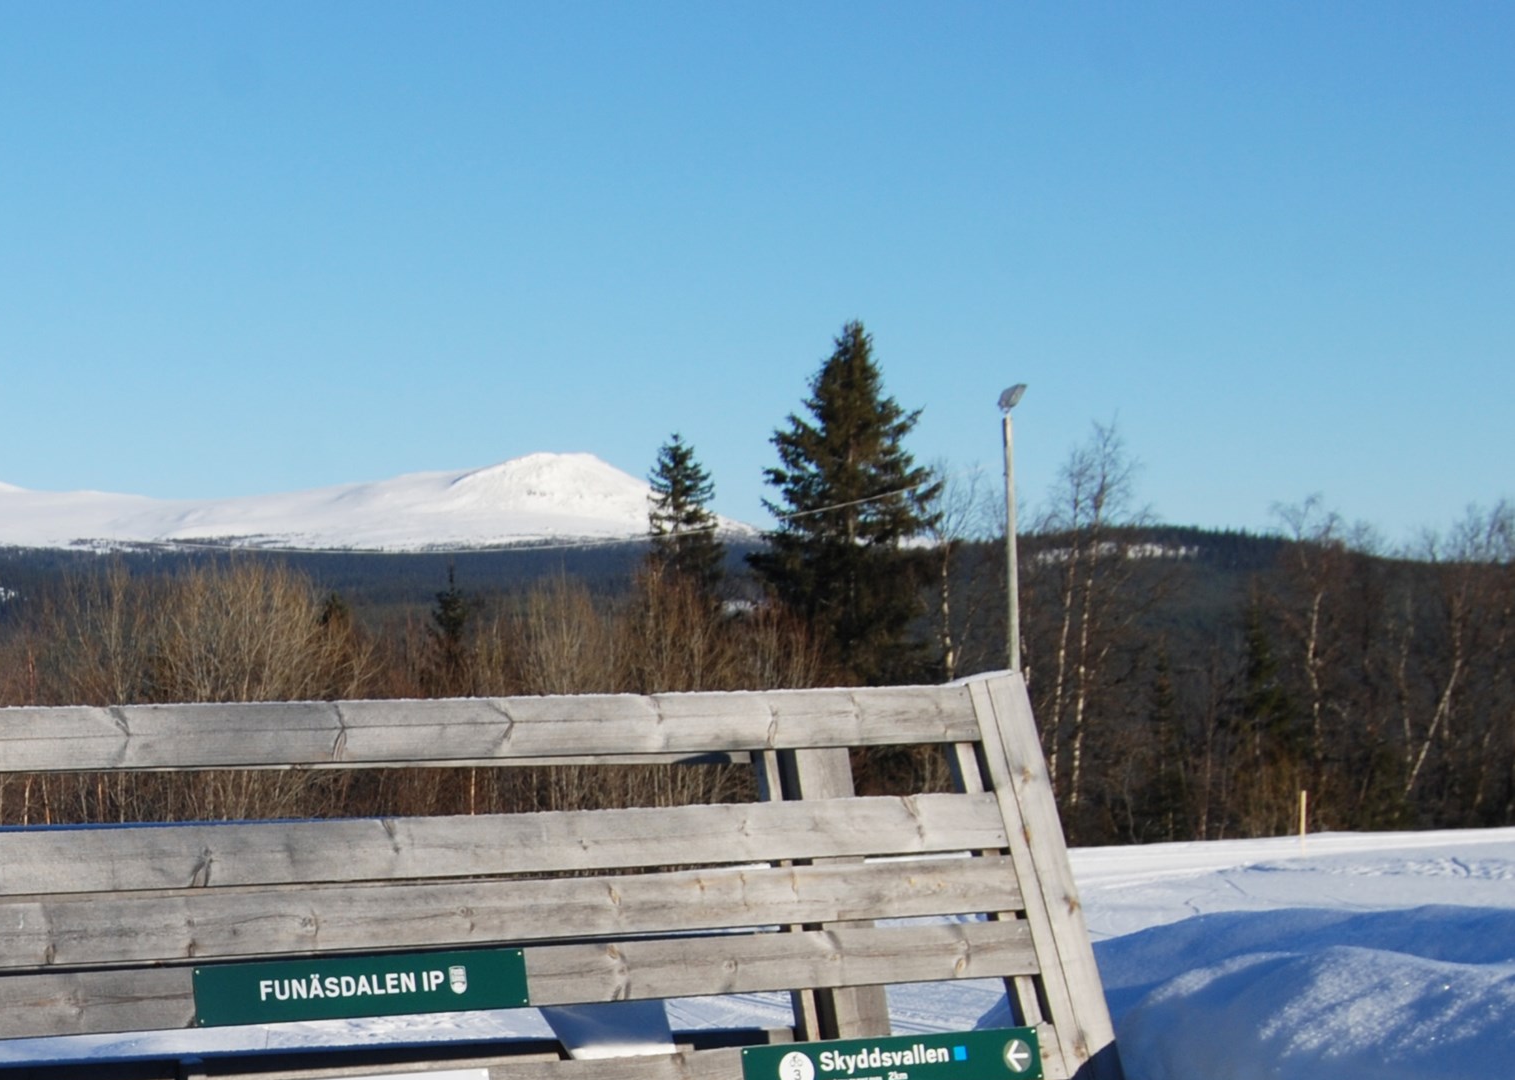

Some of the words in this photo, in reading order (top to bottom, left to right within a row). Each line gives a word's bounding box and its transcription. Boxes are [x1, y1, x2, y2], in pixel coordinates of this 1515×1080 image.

[259, 972, 417, 1001] FUNÄSDALEN
[421, 970, 445, 991] IP
[819, 1043, 950, 1074] Skyddsvallen
[793, 1069, 801, 1080] 3
